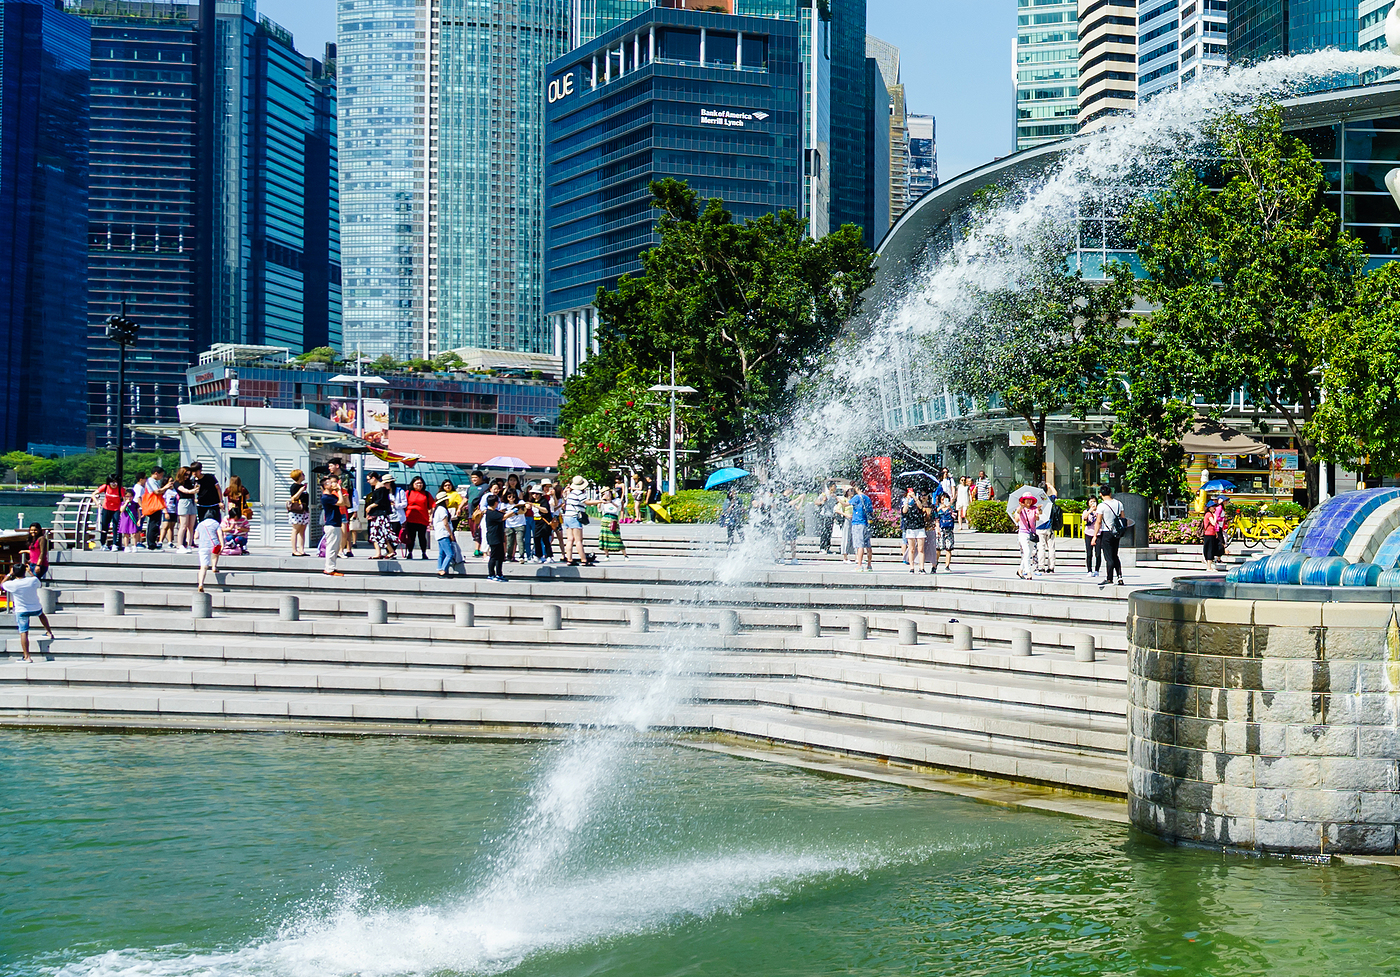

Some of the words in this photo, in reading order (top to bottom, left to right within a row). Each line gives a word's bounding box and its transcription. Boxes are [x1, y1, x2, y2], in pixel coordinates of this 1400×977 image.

[548, 72, 574, 103] OUE
[700, 108, 718, 117] Bank
[725, 110, 752, 120] America
[724, 118, 744, 127] Lynch
